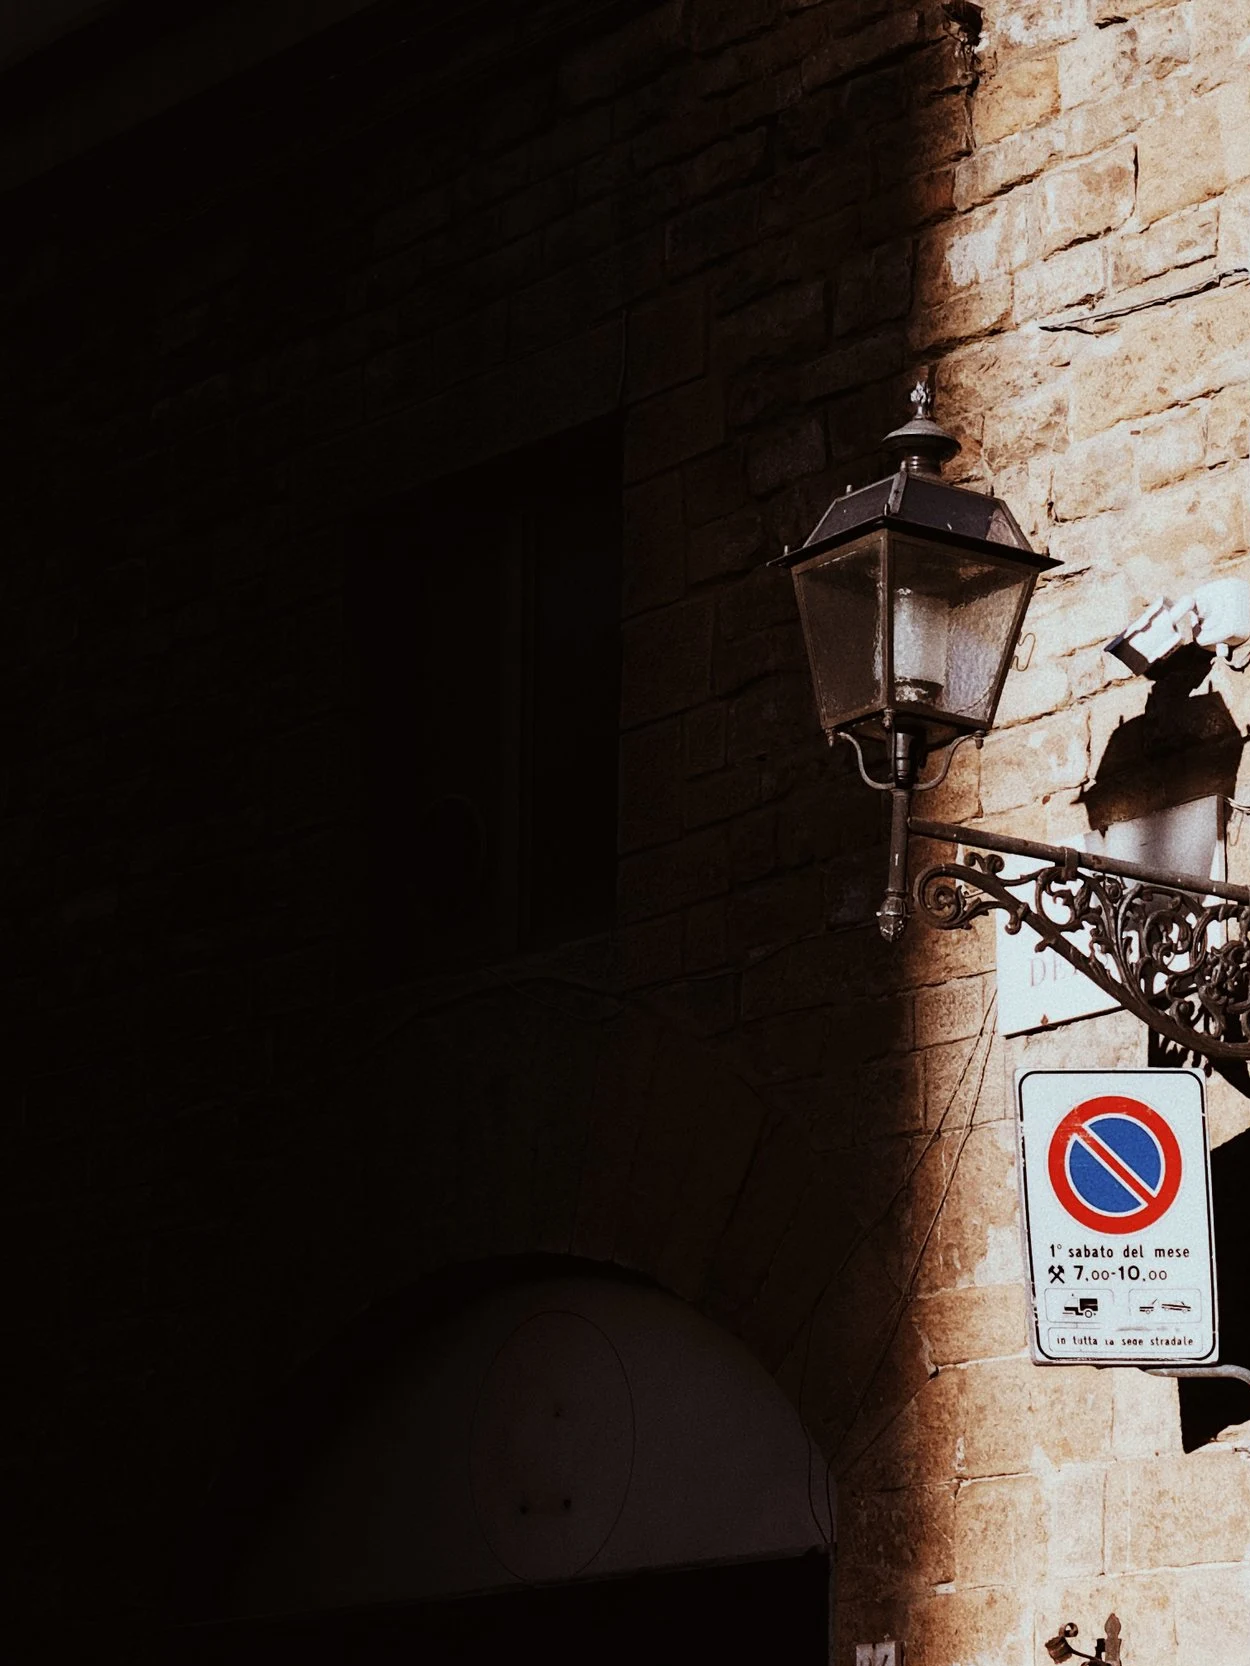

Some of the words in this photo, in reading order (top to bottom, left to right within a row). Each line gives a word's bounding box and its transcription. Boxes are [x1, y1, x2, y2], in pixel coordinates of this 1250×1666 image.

[1068, 1244, 1114, 1259] sabato
[1123, 1244, 1144, 1259] del
[1154, 1247, 1190, 1259] mese
[1150, 1335, 1194, 1347] stradale
